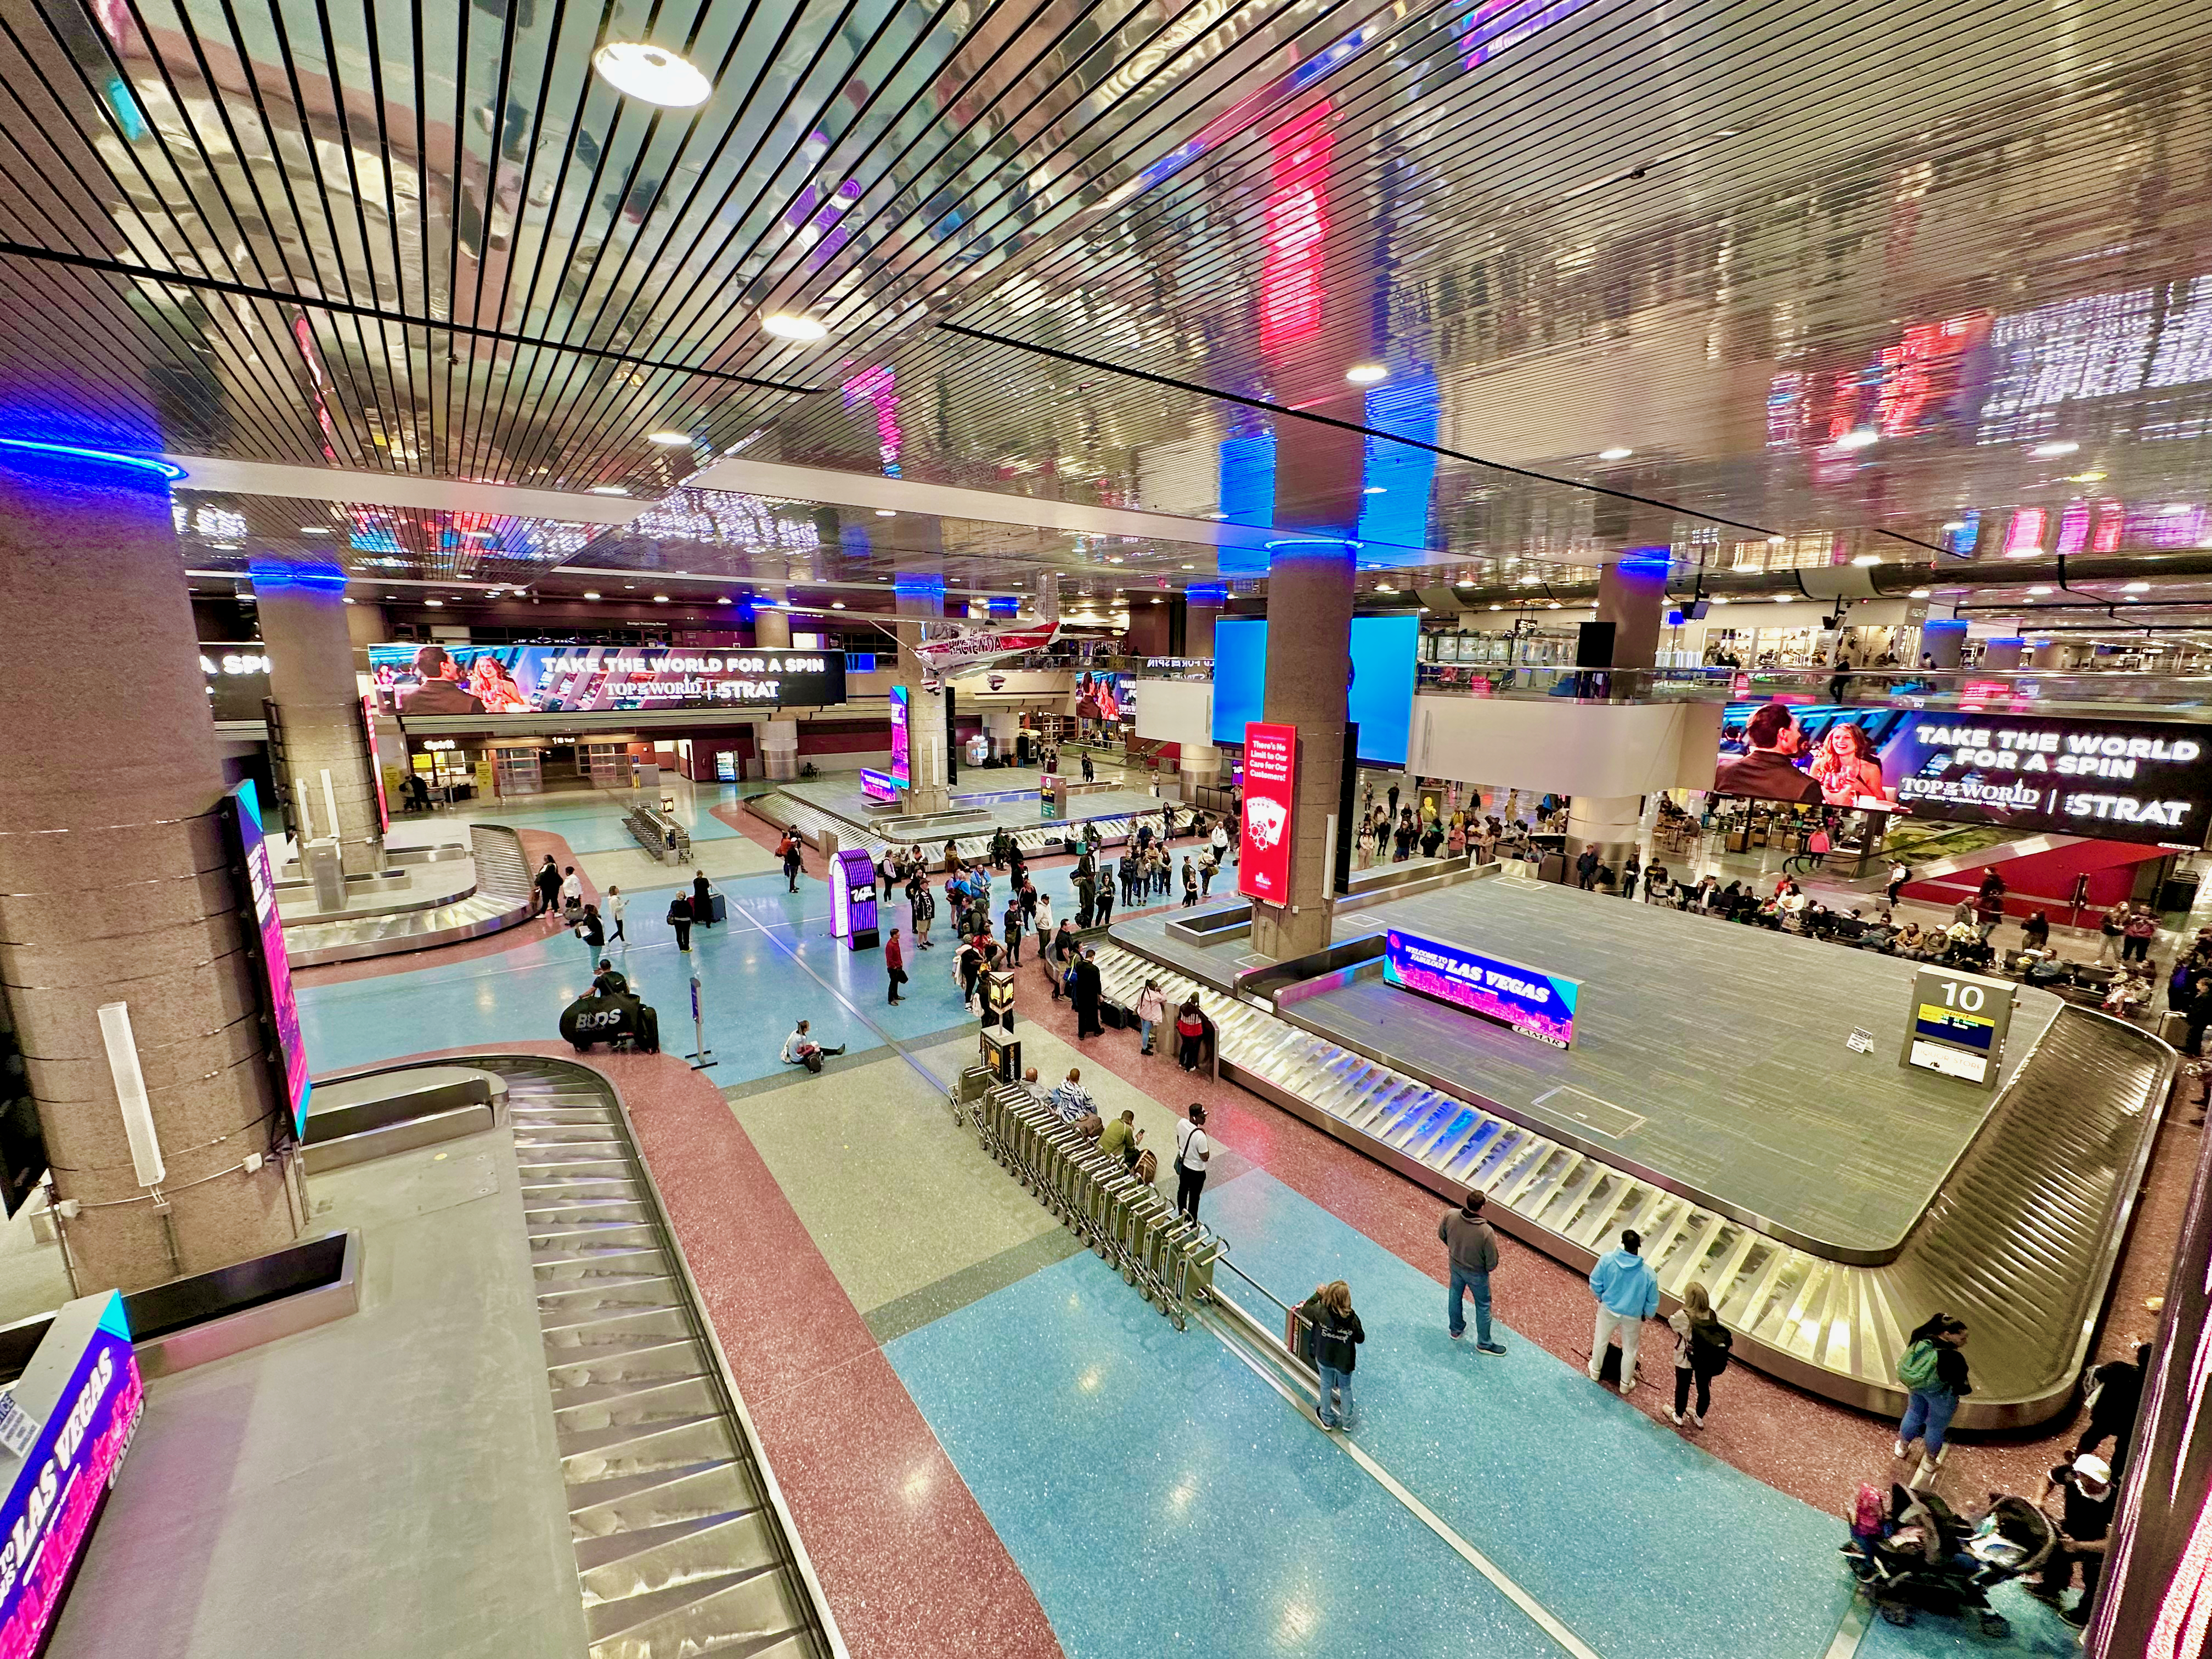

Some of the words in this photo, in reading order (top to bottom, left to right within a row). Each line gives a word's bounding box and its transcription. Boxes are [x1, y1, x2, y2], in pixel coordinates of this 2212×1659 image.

[949, 636, 1003, 655] HACIENDA
[541, 657, 600, 673] TAKE
[603, 657, 645, 673] THE
[650, 657, 723, 673] WORLD
[726, 658, 765, 673] FOR
[768, 658, 783, 672] A
[785, 658, 825, 673] SPIN
[605, 682, 637, 696] TOP
[647, 674, 702, 695] WORLD
[720, 681, 780, 699] STRAT
[424, 739, 455, 751] Spirit
[1252, 741, 1276, 751] There's
[1277, 743, 1286, 752] No
[1916, 726, 1991, 747] TAKE
[1997, 730, 2059, 752] THE
[2067, 735, 2200, 761] WORLD
[1249, 759, 1264, 768] Care
[1275, 763, 1288, 771] Our
[1251, 750, 1266, 759] Limit
[1275, 753, 1288, 761] Our
[1955, 748, 2018, 769] FOR
[2022, 753, 2048, 772] A
[2055, 755, 2136, 778] SPIN
[1046, 777, 1052, 789] 9
[1250, 769, 1286, 781] Customers!
[1901, 777, 1944, 794] TOP
[1961, 778, 2040, 803] WORLD
[2070, 794, 2192, 826] STRAT
[1405, 945, 1438, 961] WELCOME
[1438, 956, 1448, 964] TO
[1410, 953, 1444, 970] FABULOUS
[1445, 958, 1483, 981] LAS
[1486, 970, 1550, 1003] VEGAS
[1941, 982, 1984, 1011] 10
[1944, 1011, 1970, 1019] spirit
[1516, 1026, 1561, 1046] LAMAR
[1915, 1048, 1949, 1062] LIQUOR
[1954, 1057, 1982, 1070] STORE
[12, 1459, 58, 1569] LAS
[54, 1346, 113, 1472] VEGAS
